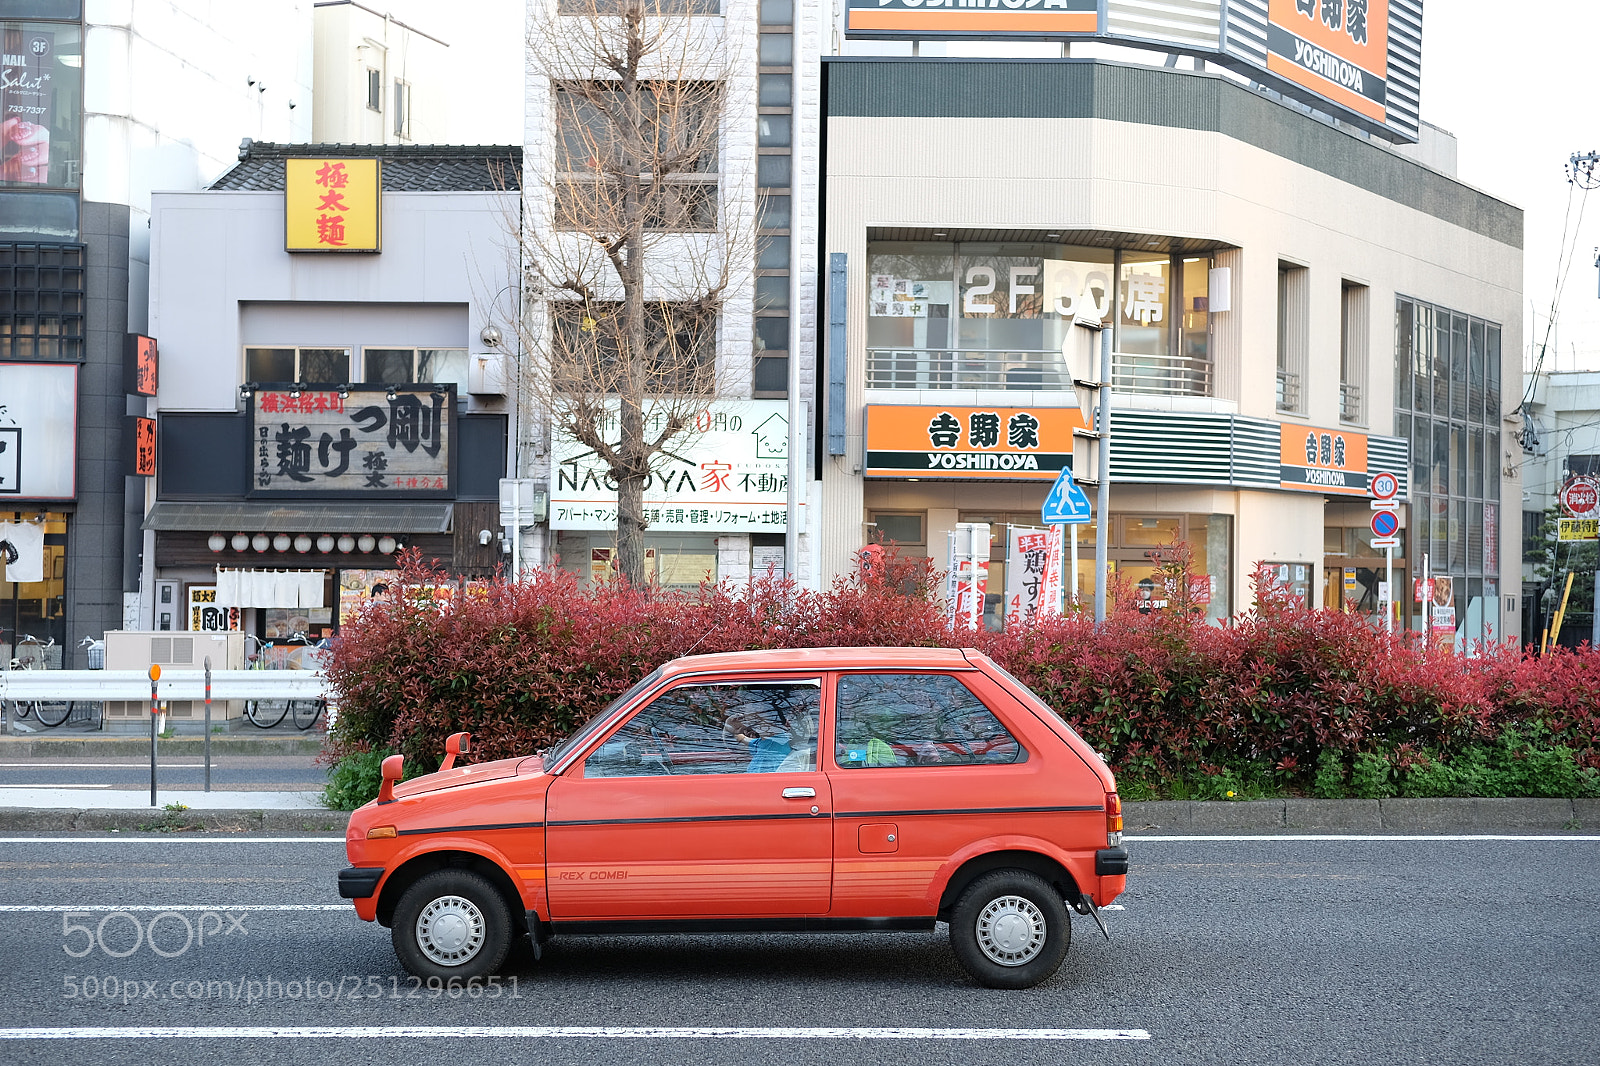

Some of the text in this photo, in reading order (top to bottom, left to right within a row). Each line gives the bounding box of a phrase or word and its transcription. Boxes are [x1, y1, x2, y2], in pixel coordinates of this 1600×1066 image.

[32, 41, 46, 53] 3F
[2, 54, 27, 67] NAIL
[1294, 38, 1364, 93] YOSHINOYA
[8, 105, 47, 115] 733-7337
[315, 161, 350, 246] 極太麺
[260, 391, 345, 415] 横浜桜木町
[927, 411, 1040, 450] 吉野家
[1304, 430, 1346, 468] 吉野家
[362, 450, 389, 489] 極太
[927, 453, 1039, 470] YOSHINOYA
[1304, 468, 1346, 486] YOSHINOYA
[1377, 480, 1393, 493] 30
[1568, 492, 1596, 505] 消火栓
[1020, 535, 1046, 552] 半玉
[559, 870, 629, 881] REX COMBI
